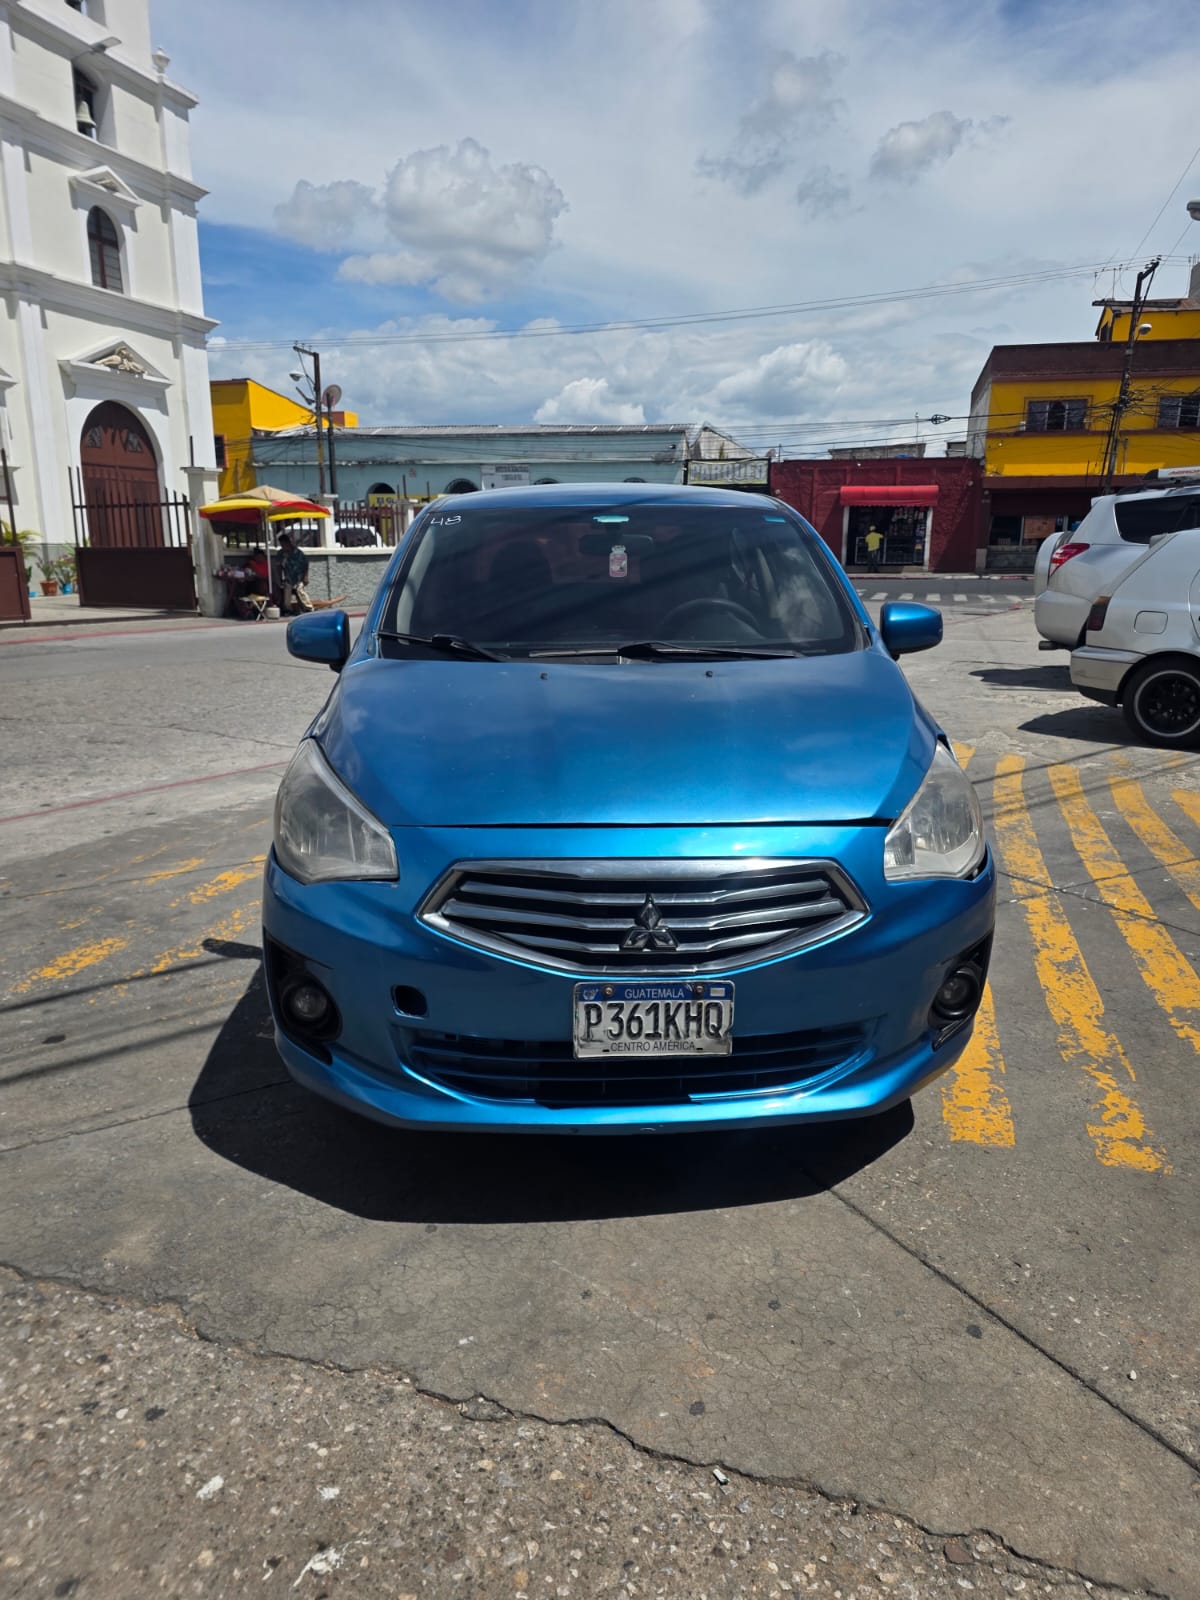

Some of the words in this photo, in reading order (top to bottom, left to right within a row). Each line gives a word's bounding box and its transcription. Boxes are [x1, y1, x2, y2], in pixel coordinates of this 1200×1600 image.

[430, 515, 462, 526] 48
[624, 988, 684, 999] GUATEMALA
[583, 1001, 723, 1040] P361KHQ
[610, 1042, 650, 1052] CENTRO
[653, 1040, 696, 1050] AMÉRICA
